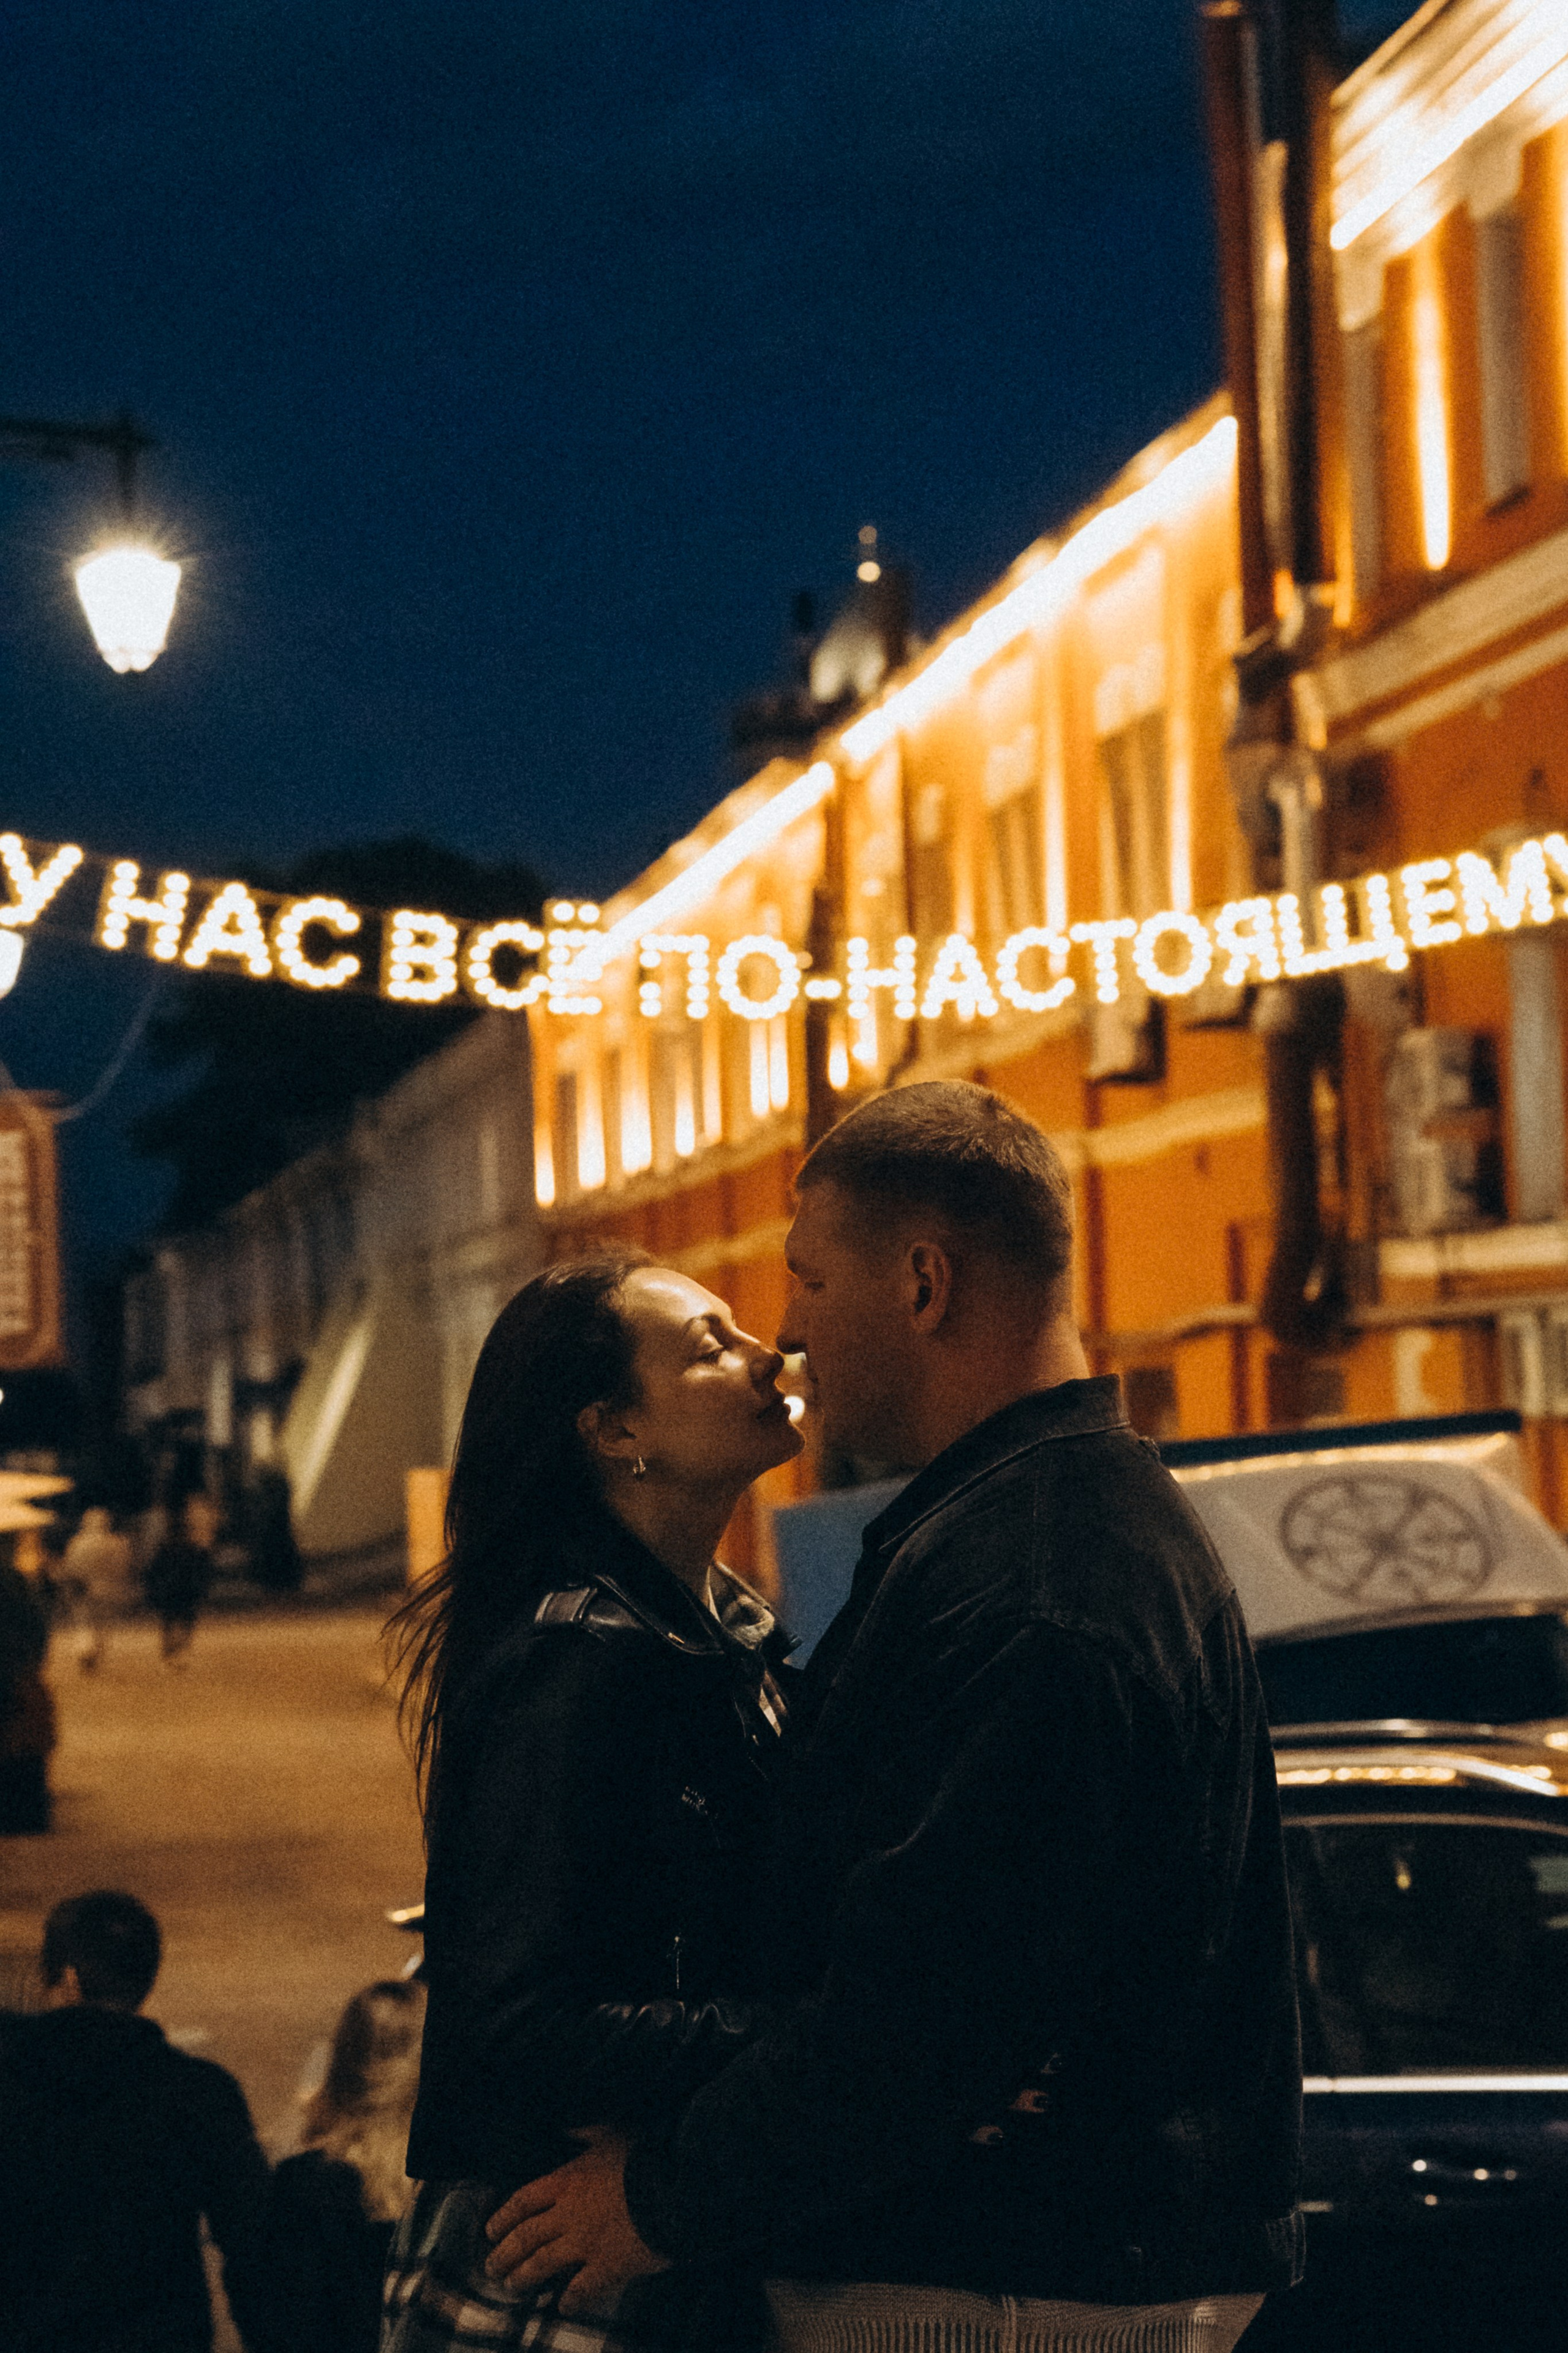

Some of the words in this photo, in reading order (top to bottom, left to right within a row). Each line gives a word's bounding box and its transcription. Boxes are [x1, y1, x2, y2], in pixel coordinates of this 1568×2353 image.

[0, 833, 83, 926] У
[100, 860, 360, 988] НАС
[387, 902, 603, 1014] ВСЁ
[639, 832, 1568, 1019] ПО-НАСТОЯЩЕМ
